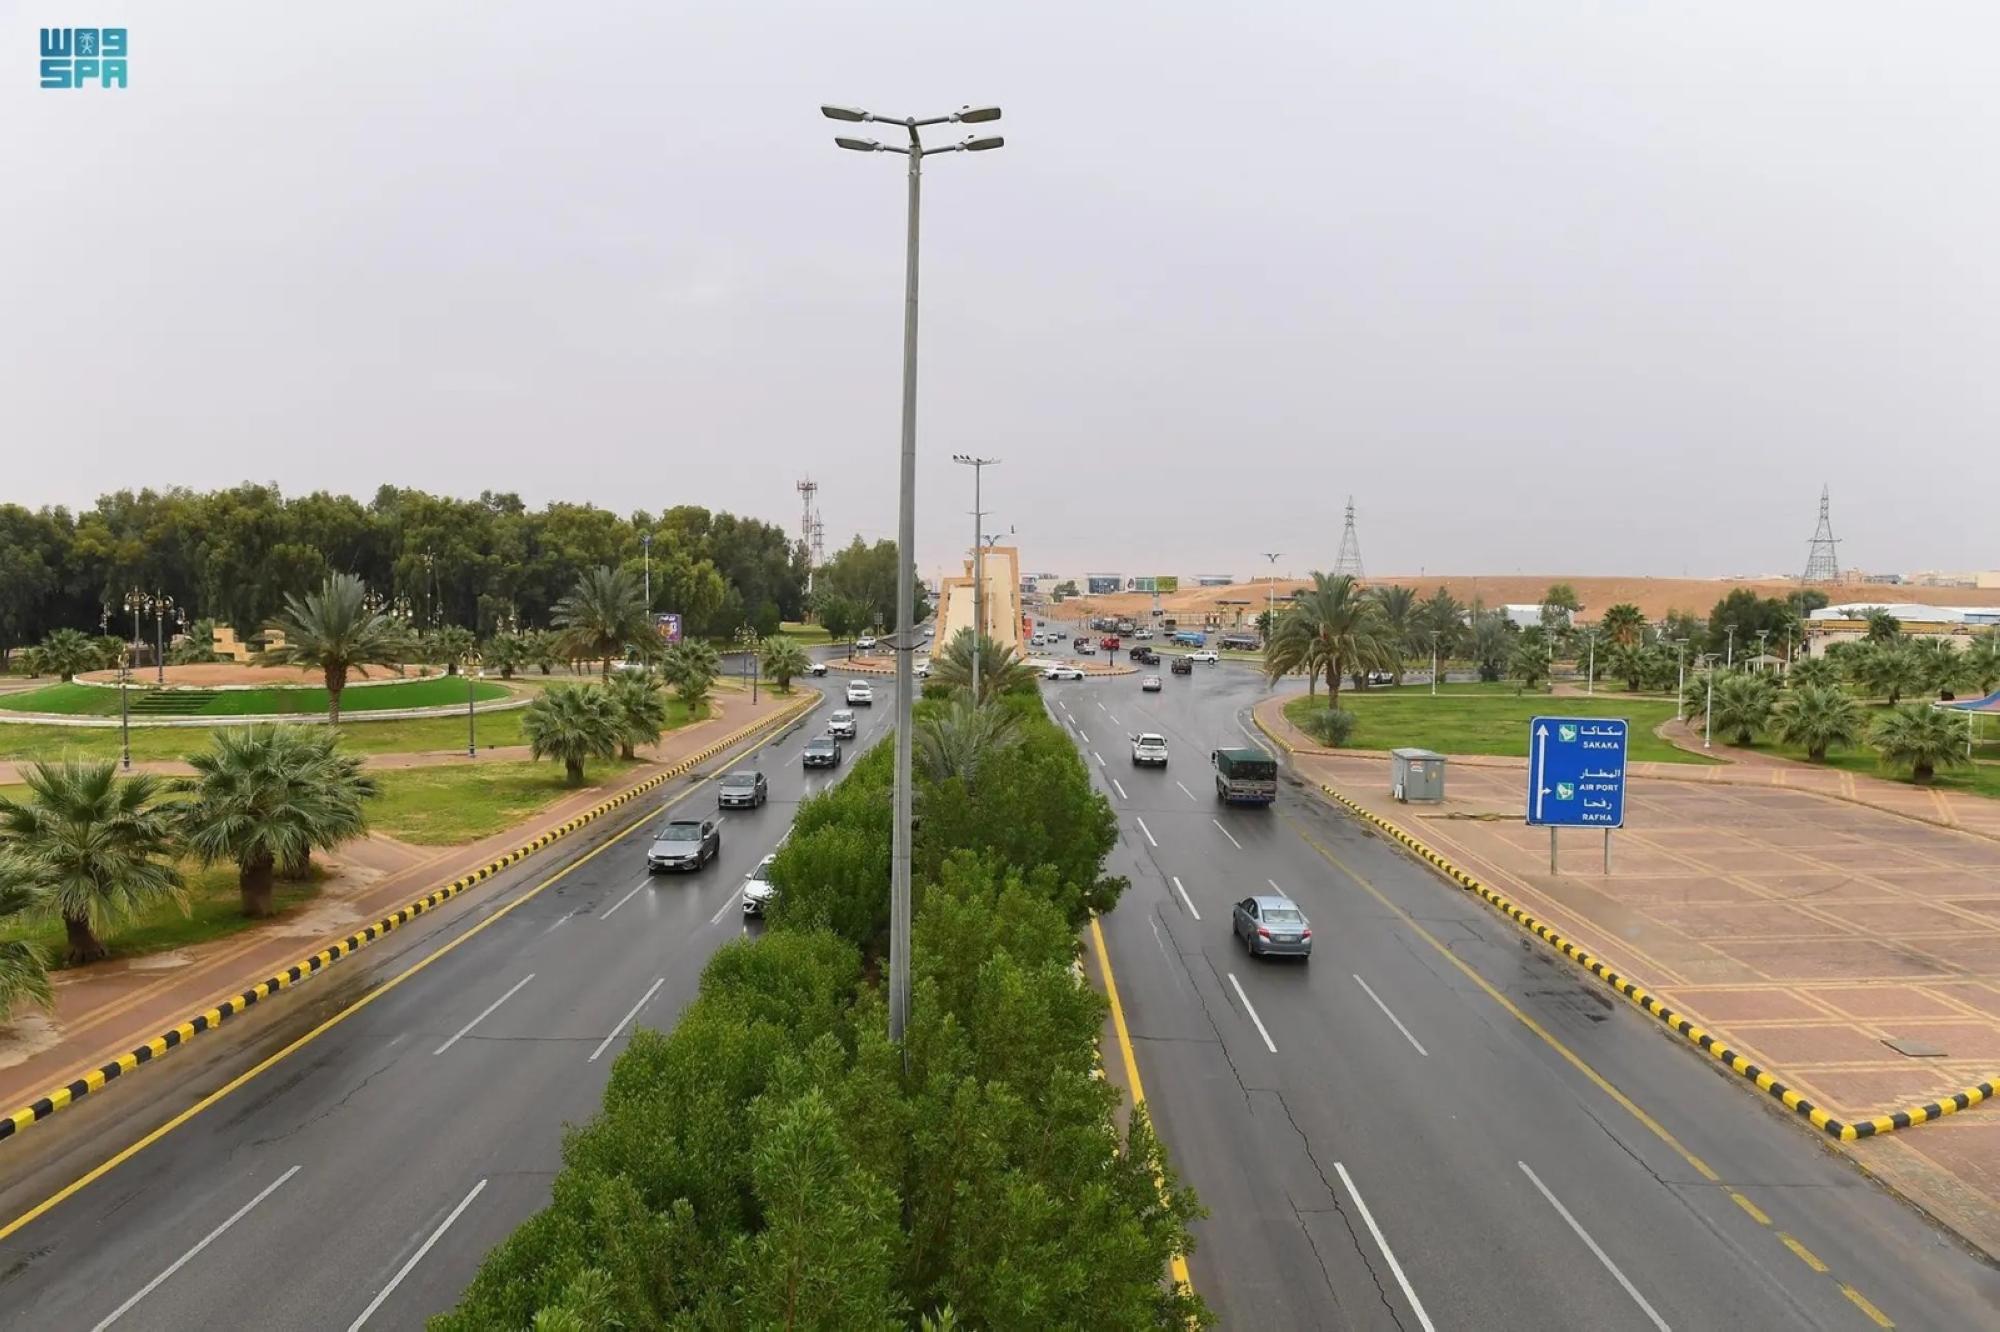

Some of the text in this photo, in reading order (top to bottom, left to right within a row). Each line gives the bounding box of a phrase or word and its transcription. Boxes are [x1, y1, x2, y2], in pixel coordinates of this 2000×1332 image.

[1581, 725, 1623, 736] سكاكا
[1583, 741, 1619, 749] SAKAKA
[1579, 768, 1621, 779] المطار
[1583, 798, 1613, 810] رفحا
[1582, 813, 1612, 821] RAFHA
